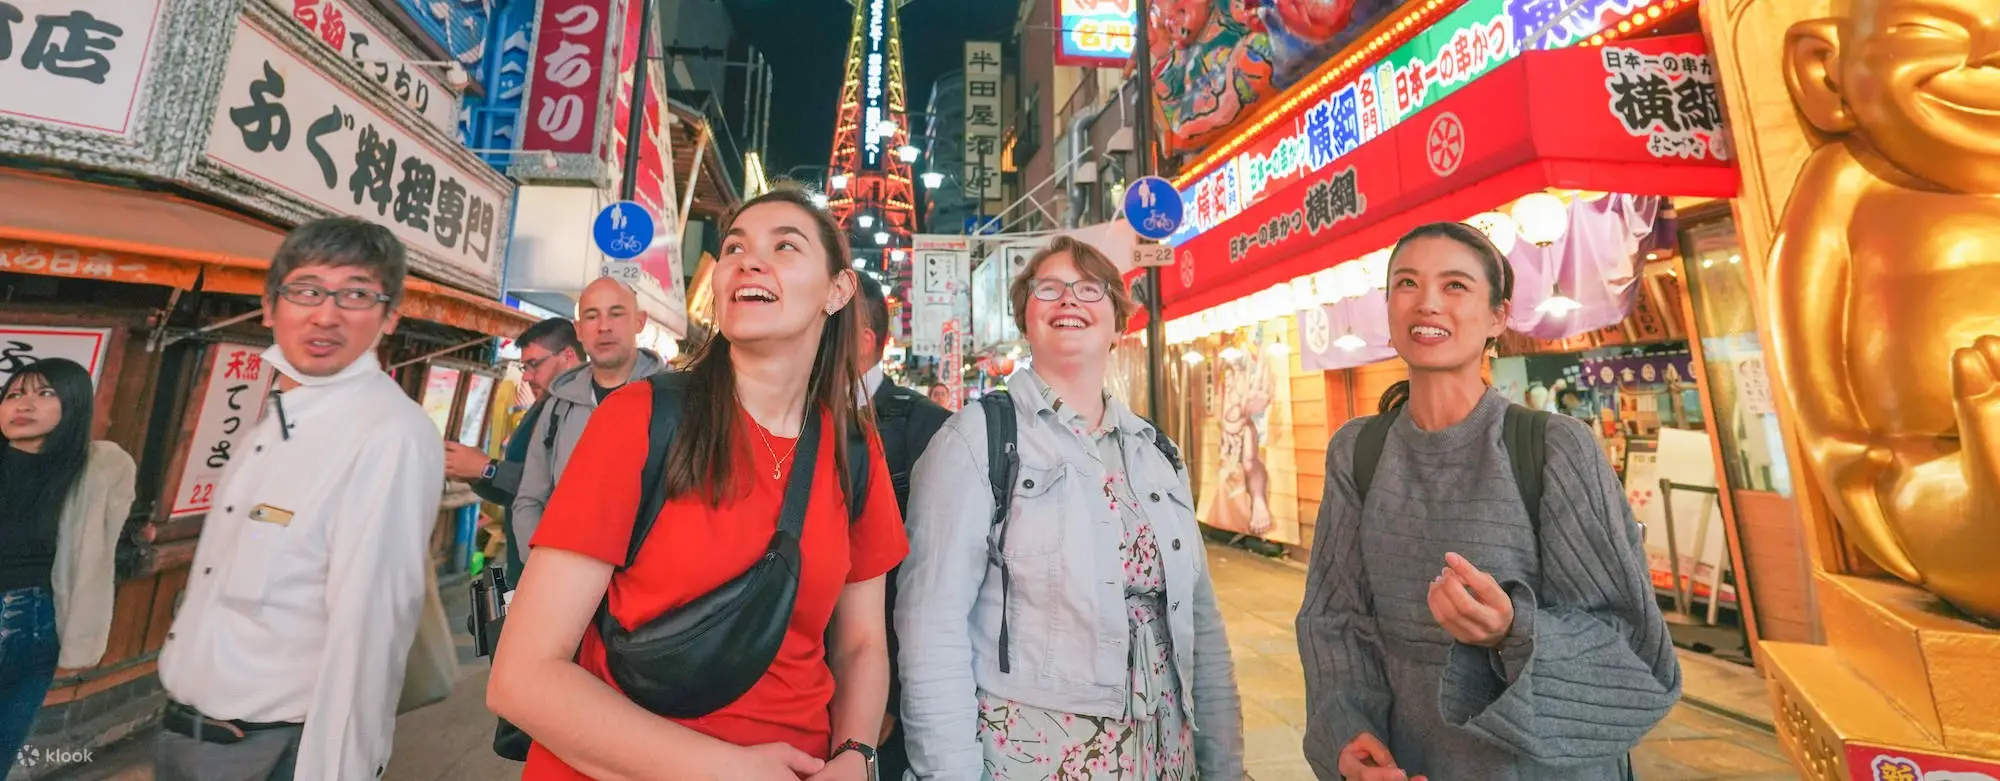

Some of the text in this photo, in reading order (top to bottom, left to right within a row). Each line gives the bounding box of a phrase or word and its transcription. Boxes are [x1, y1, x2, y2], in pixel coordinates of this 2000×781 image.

[1396, 21, 1505, 112] 日本一の串かつ
[230, 59, 494, 263] ふぐ料理専門
[966, 50, 999, 188] 半田屋酒店
[1308, 86, 1359, 168] 横綱
[1360, 78, 1378, 140] 名門
[1230, 210, 1302, 261] 日本一の串かつ
[1305, 168, 1359, 232] 横綱
[224, 351, 262, 381] 天然
